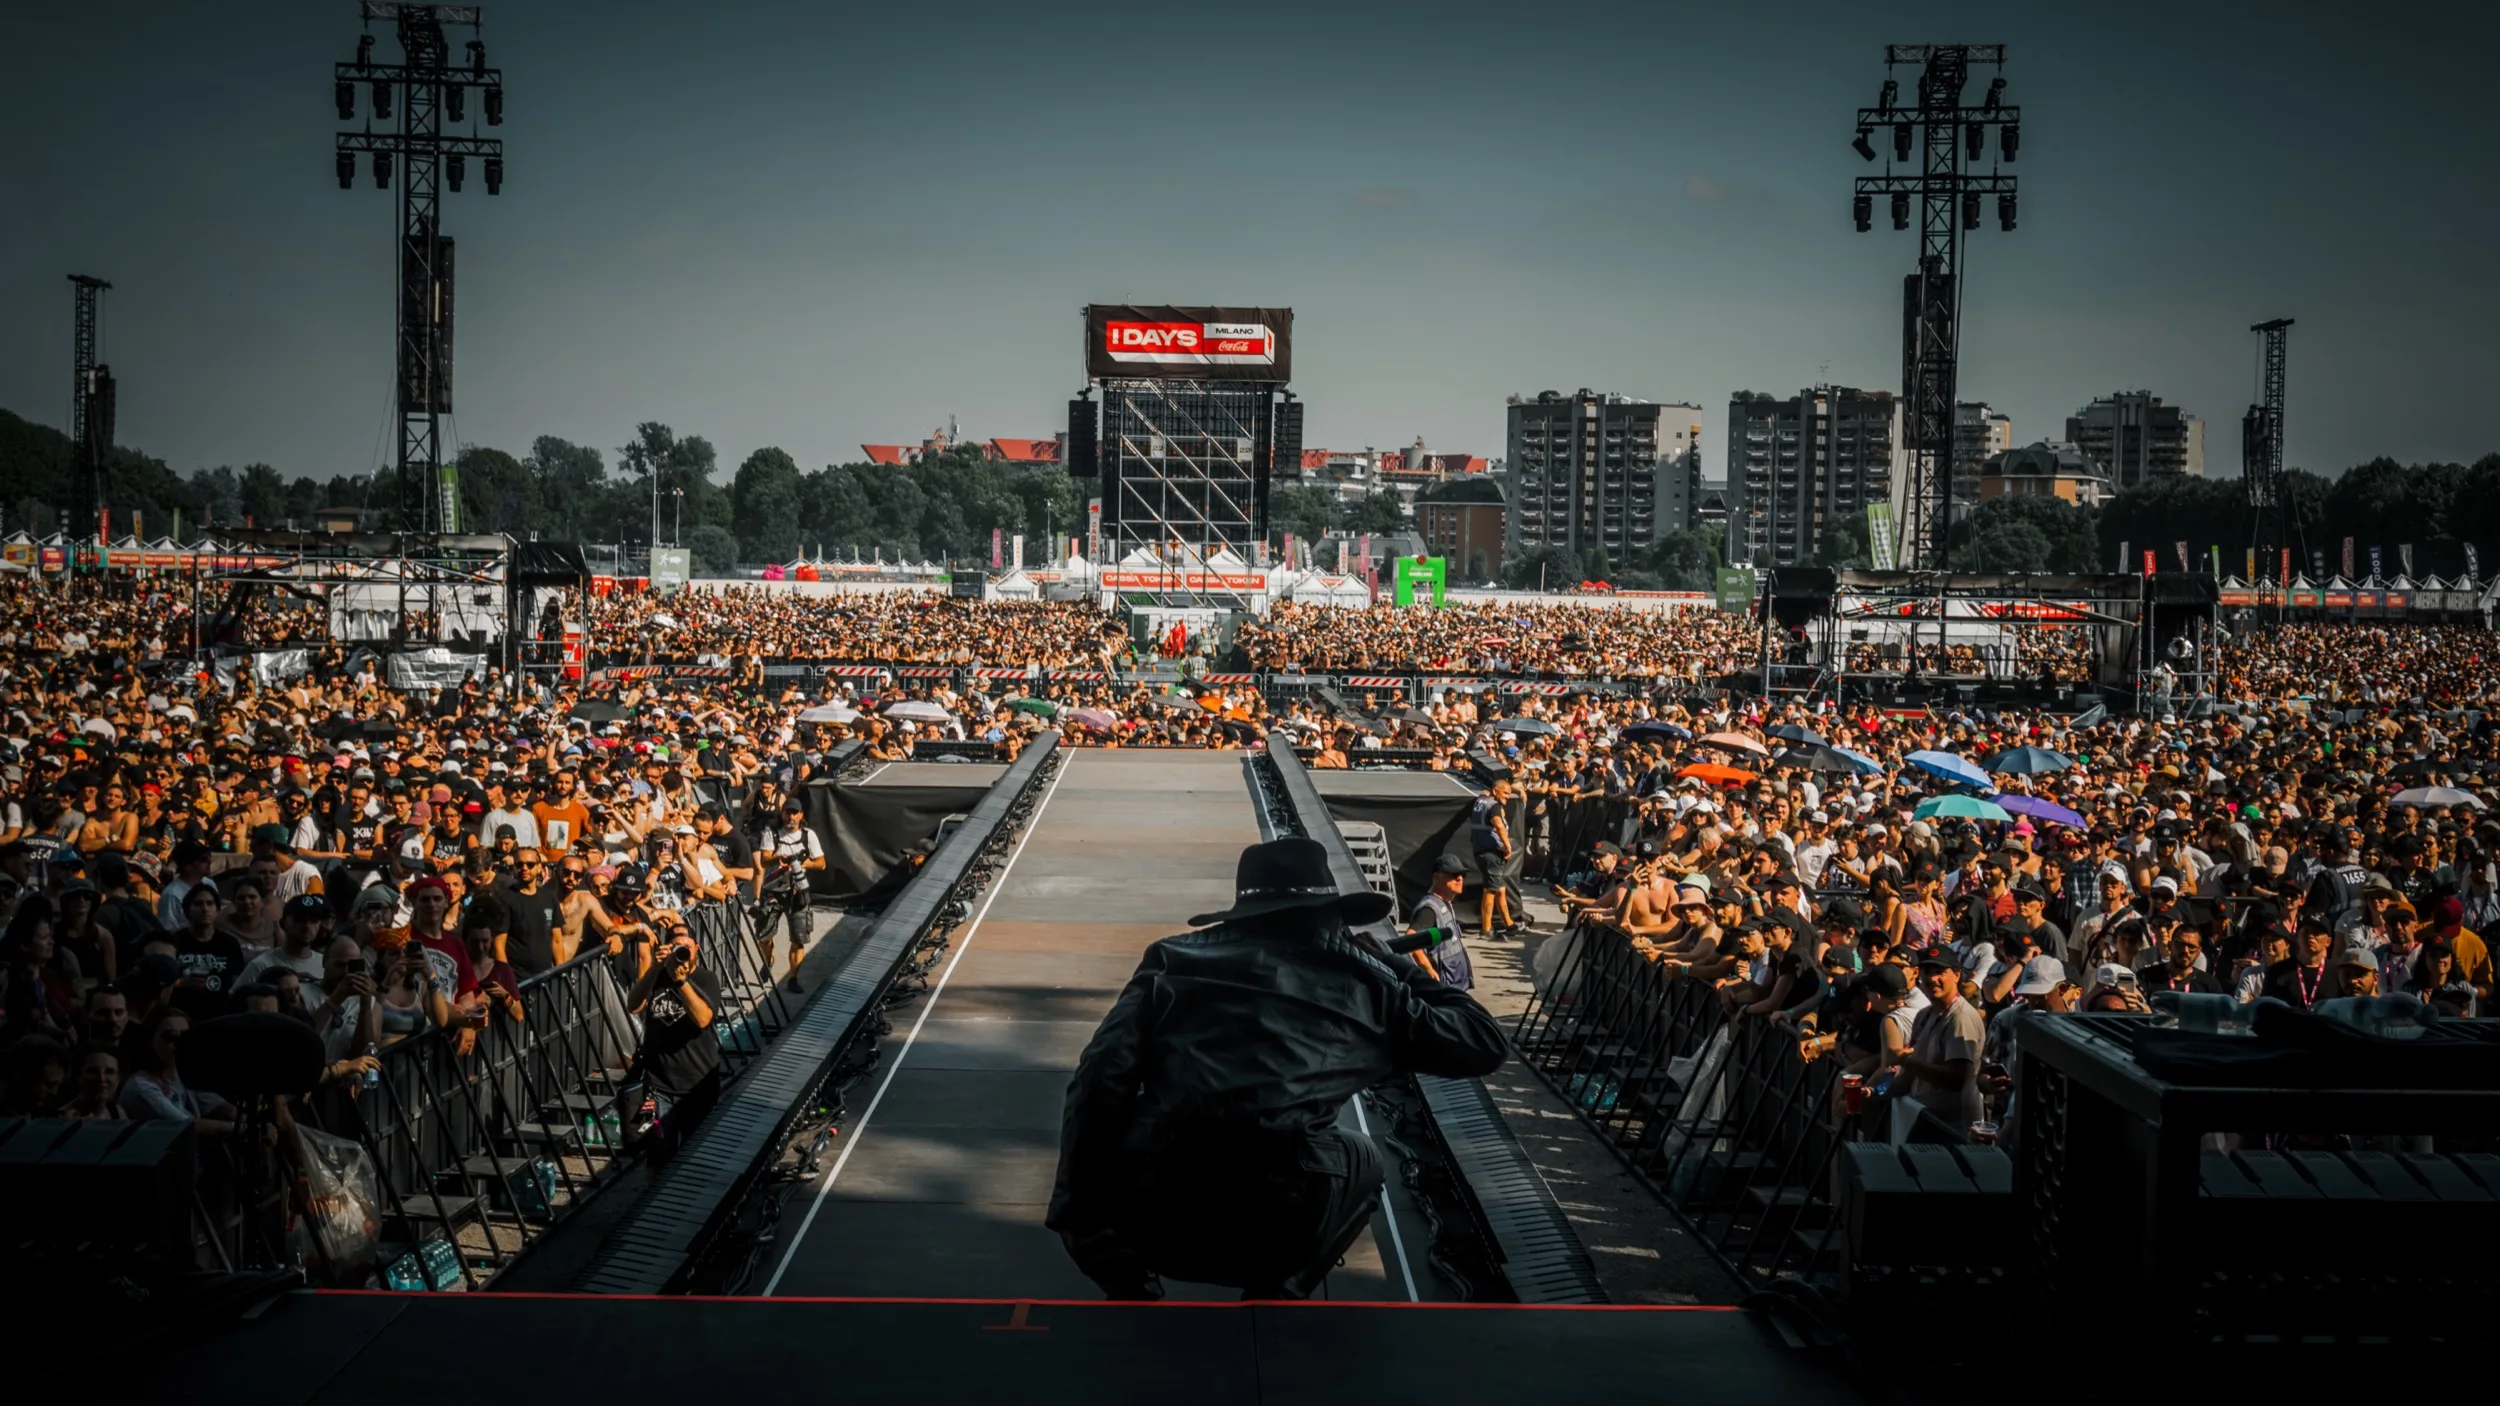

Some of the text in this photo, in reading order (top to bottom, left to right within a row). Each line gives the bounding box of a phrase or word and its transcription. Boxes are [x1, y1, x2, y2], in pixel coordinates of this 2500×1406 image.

[1215, 327, 1254, 335] MILANO
[1112, 328, 1198, 347] I DAYS
[1189, 576, 1260, 585] CASSA TOKEN
[2342, 871, 2366, 884] 1655
